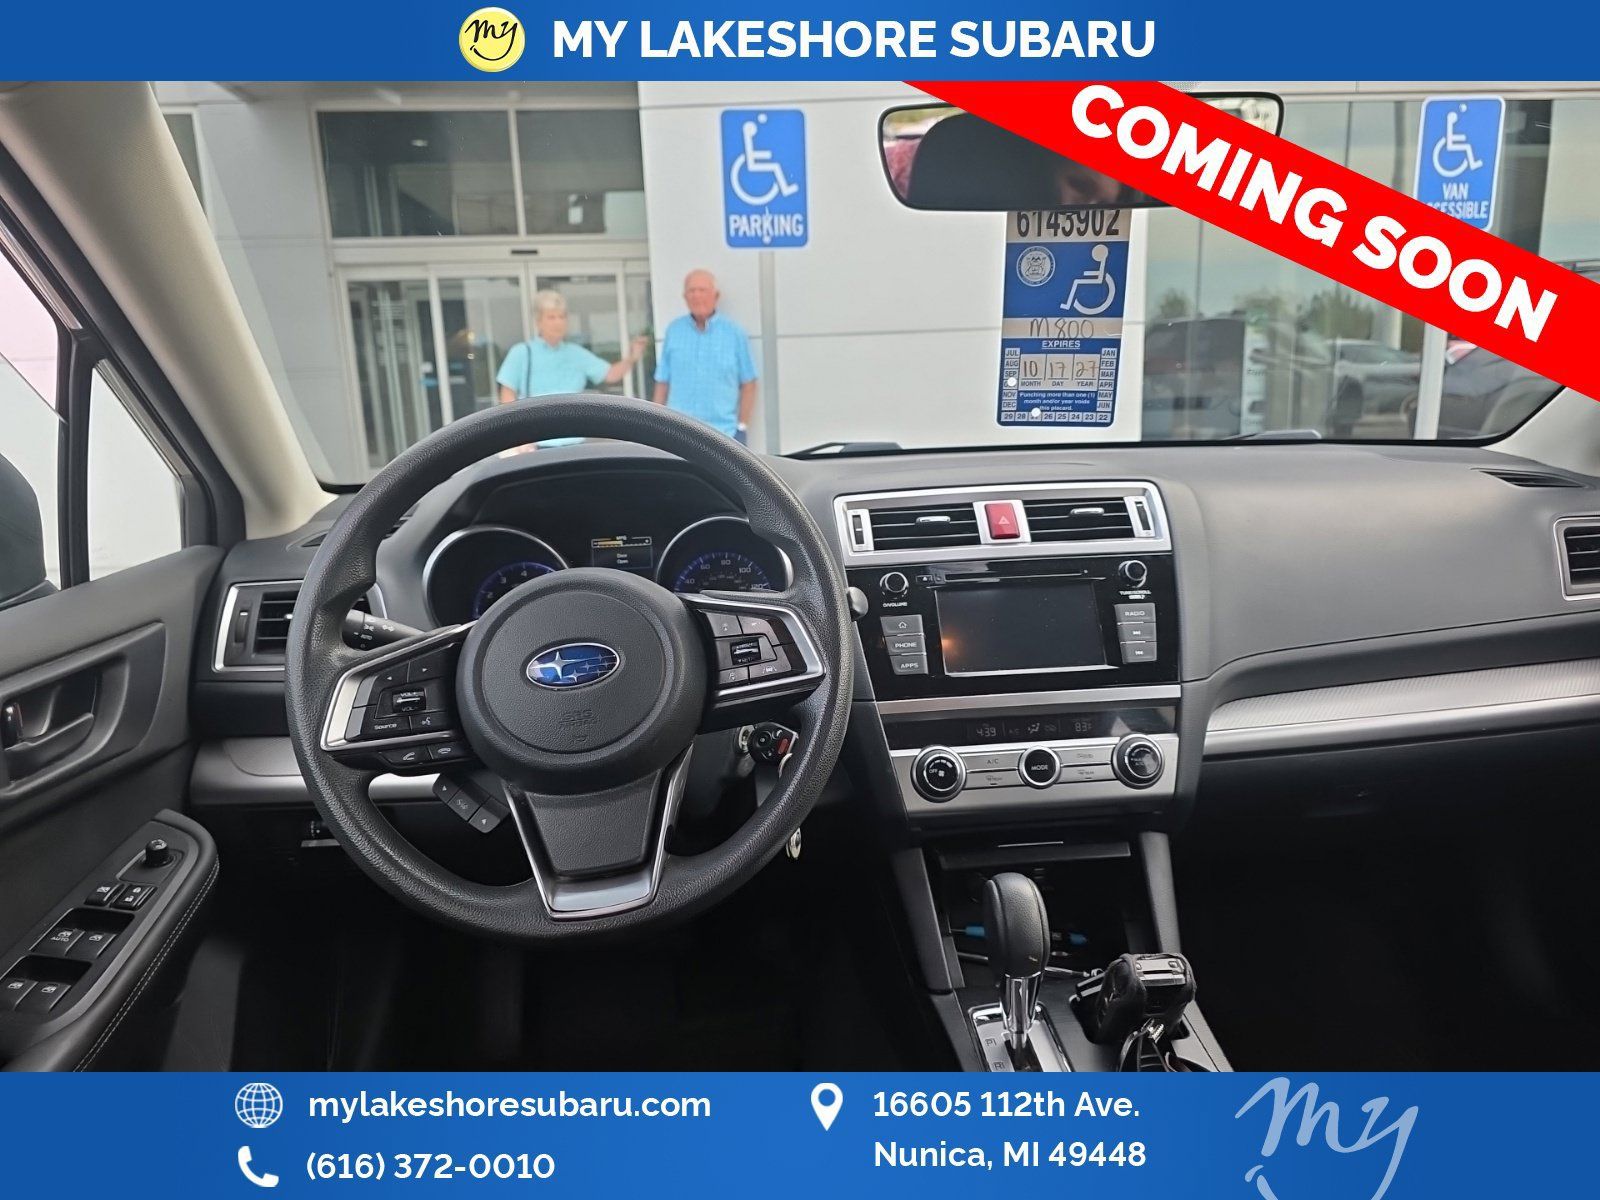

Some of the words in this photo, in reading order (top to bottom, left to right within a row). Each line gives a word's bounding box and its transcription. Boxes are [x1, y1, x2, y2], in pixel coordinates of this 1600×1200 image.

[1442, 182, 1469, 200] VAN
[729, 213, 804, 238] PARKING
[1041, 340, 1081, 348] EXPIRES
[1005, 349, 1019, 357] JUL
[1102, 349, 1116, 357] JAN
[1101, 360, 1115, 368] FEB
[1023, 360, 1038, 378] 10
[1049, 361, 1066, 378] 17
[1003, 390, 1017, 398] NOV
[1098, 391, 1112, 399] MAY
[1002, 400, 1017, 408] DEC
[1097, 401, 1111, 409] JUN
[50, 935, 70, 943] AUTO
